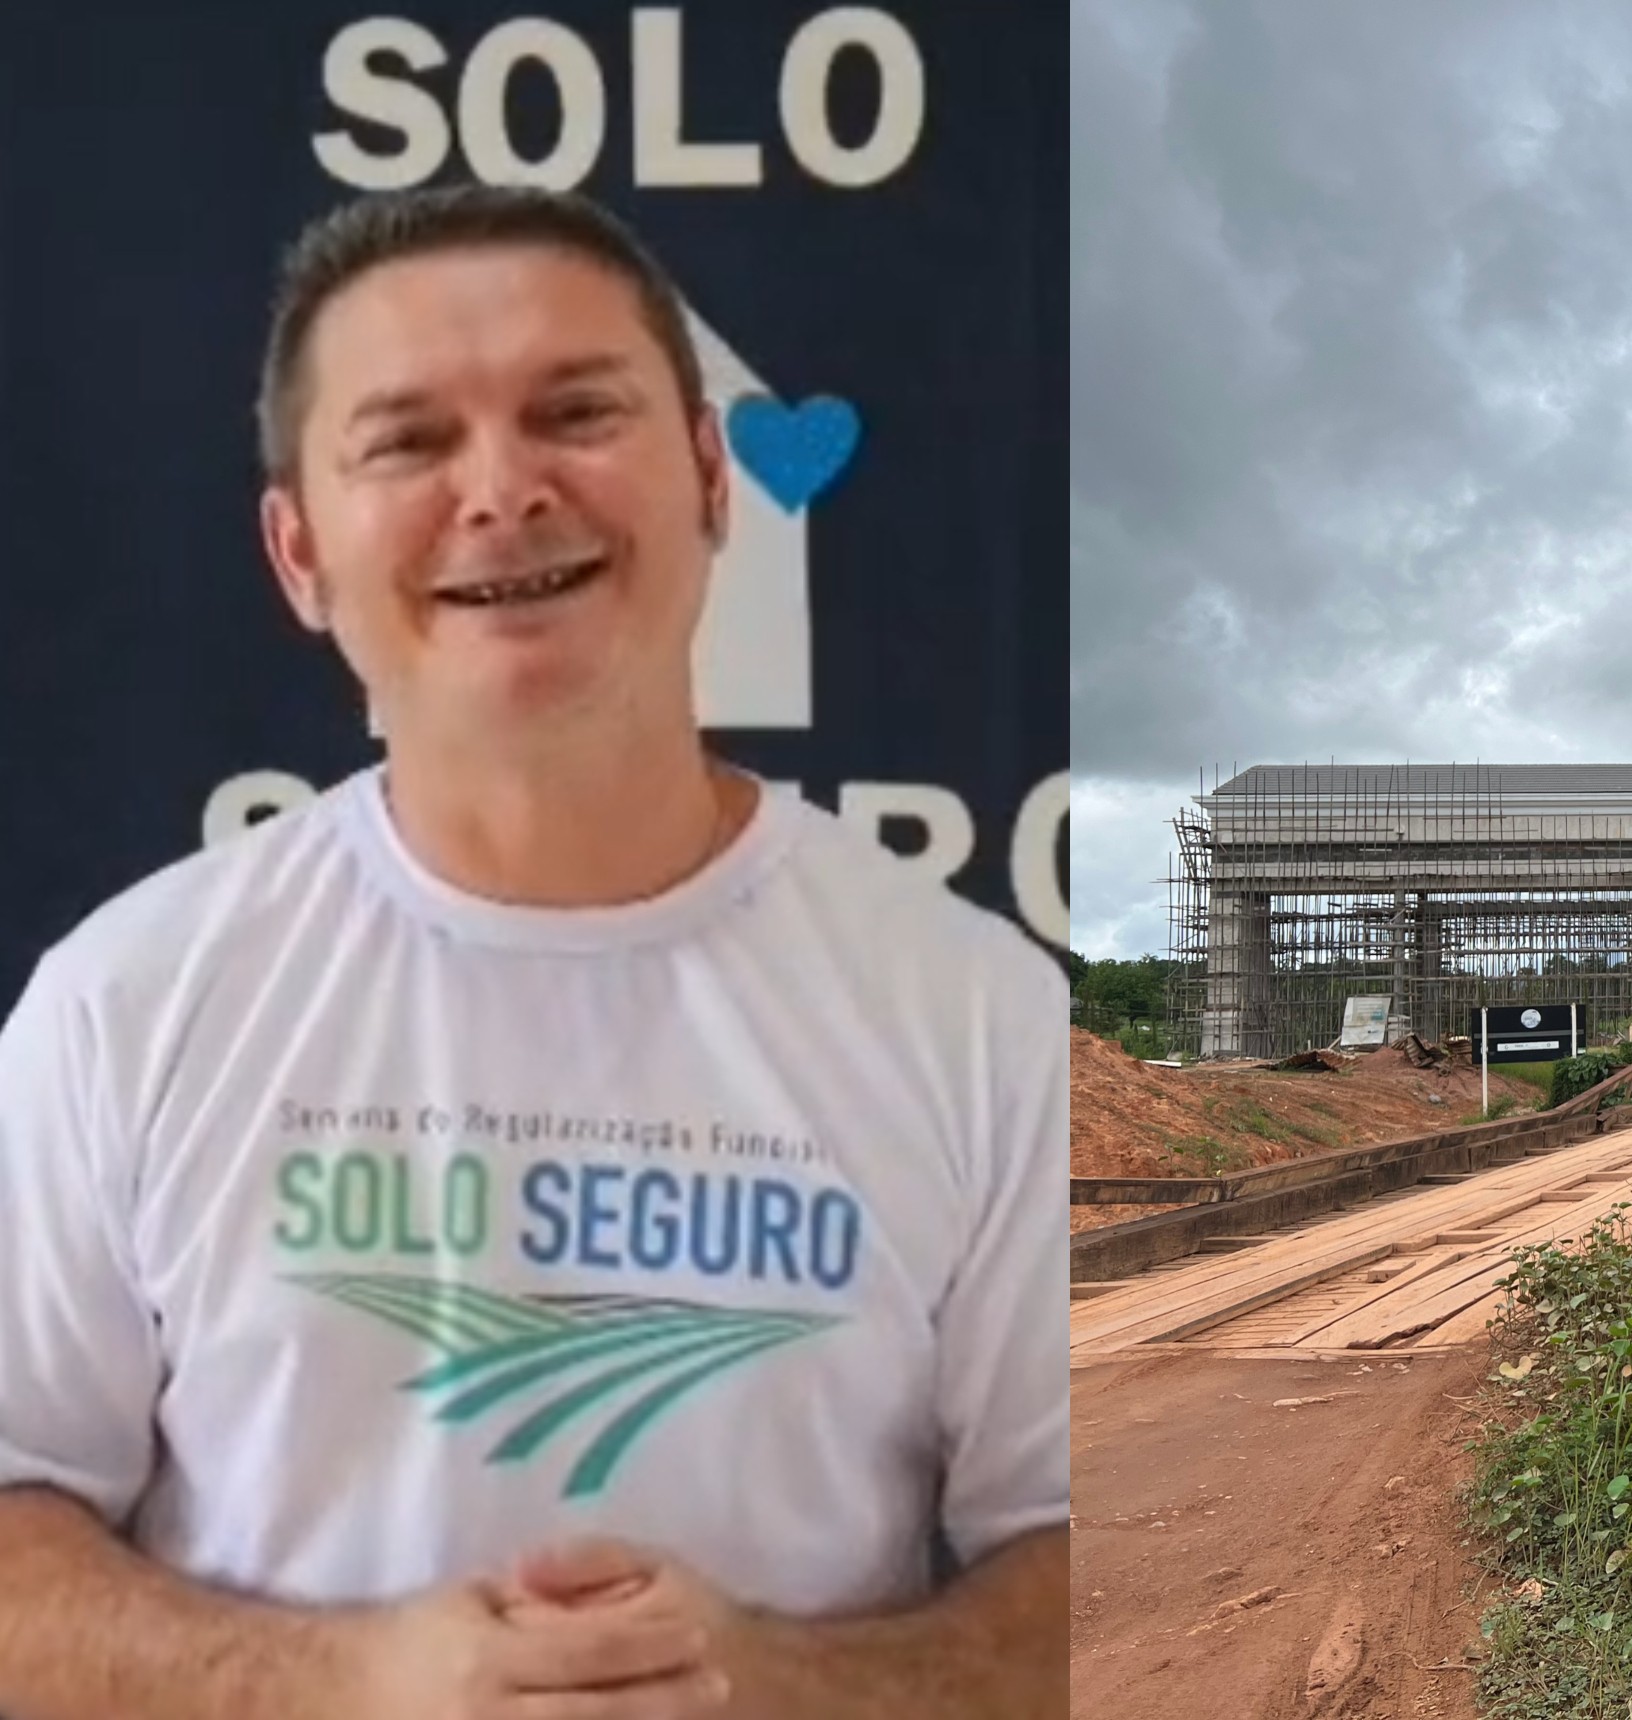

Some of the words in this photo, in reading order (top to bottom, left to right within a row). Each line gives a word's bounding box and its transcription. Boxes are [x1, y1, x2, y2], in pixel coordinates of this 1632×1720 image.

[311, 6, 925, 192] SOLO
[273, 1150, 489, 1257] SOLO
[519, 1160, 862, 1290] SEGURO
